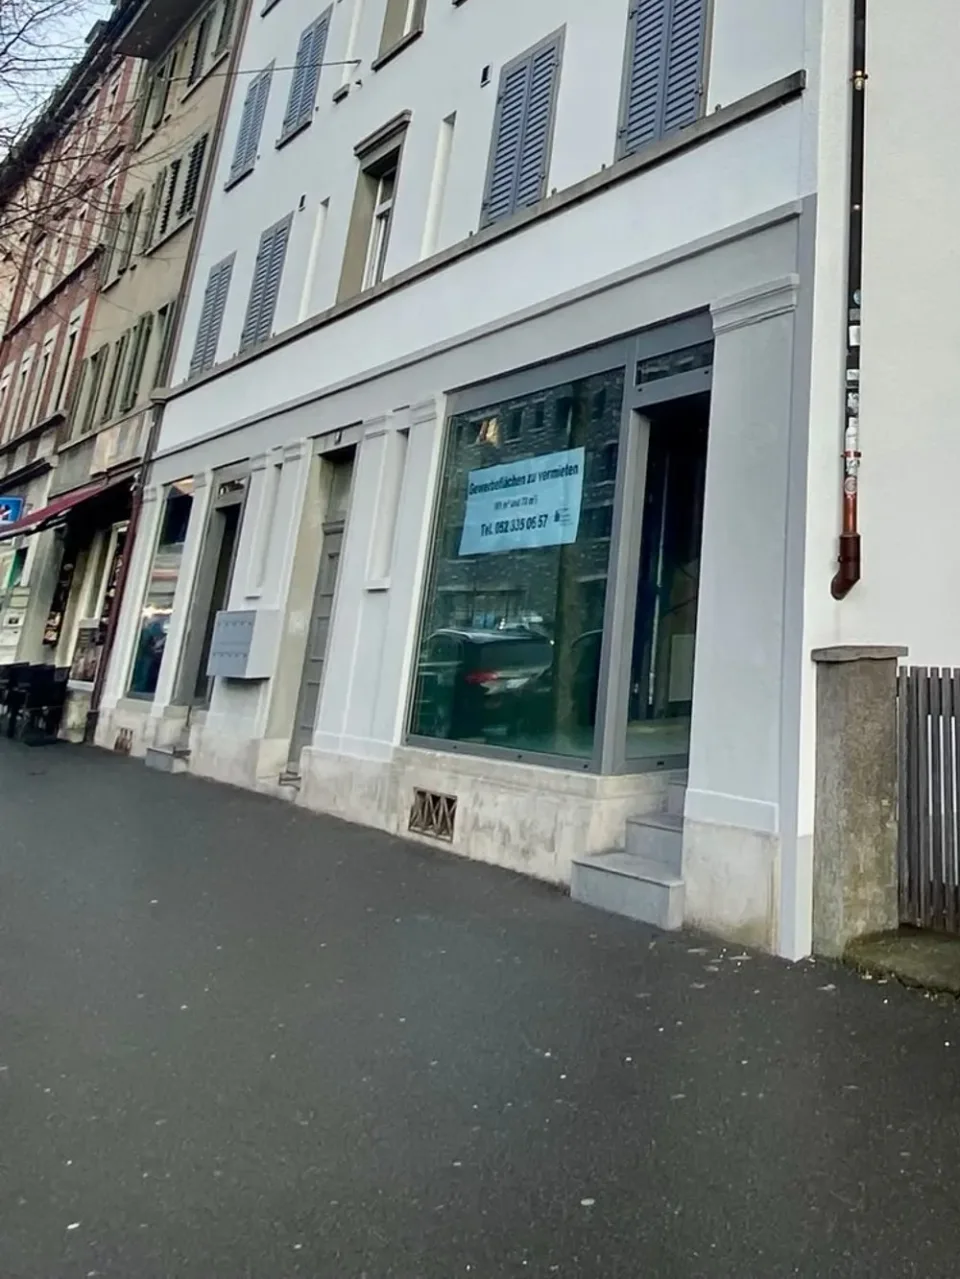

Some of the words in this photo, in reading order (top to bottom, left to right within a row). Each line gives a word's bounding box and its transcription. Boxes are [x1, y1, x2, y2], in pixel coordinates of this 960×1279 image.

[526, 473, 537, 484] zu
[538, 464, 578, 481] vermieten
[480, 523, 494, 537] Tel.
